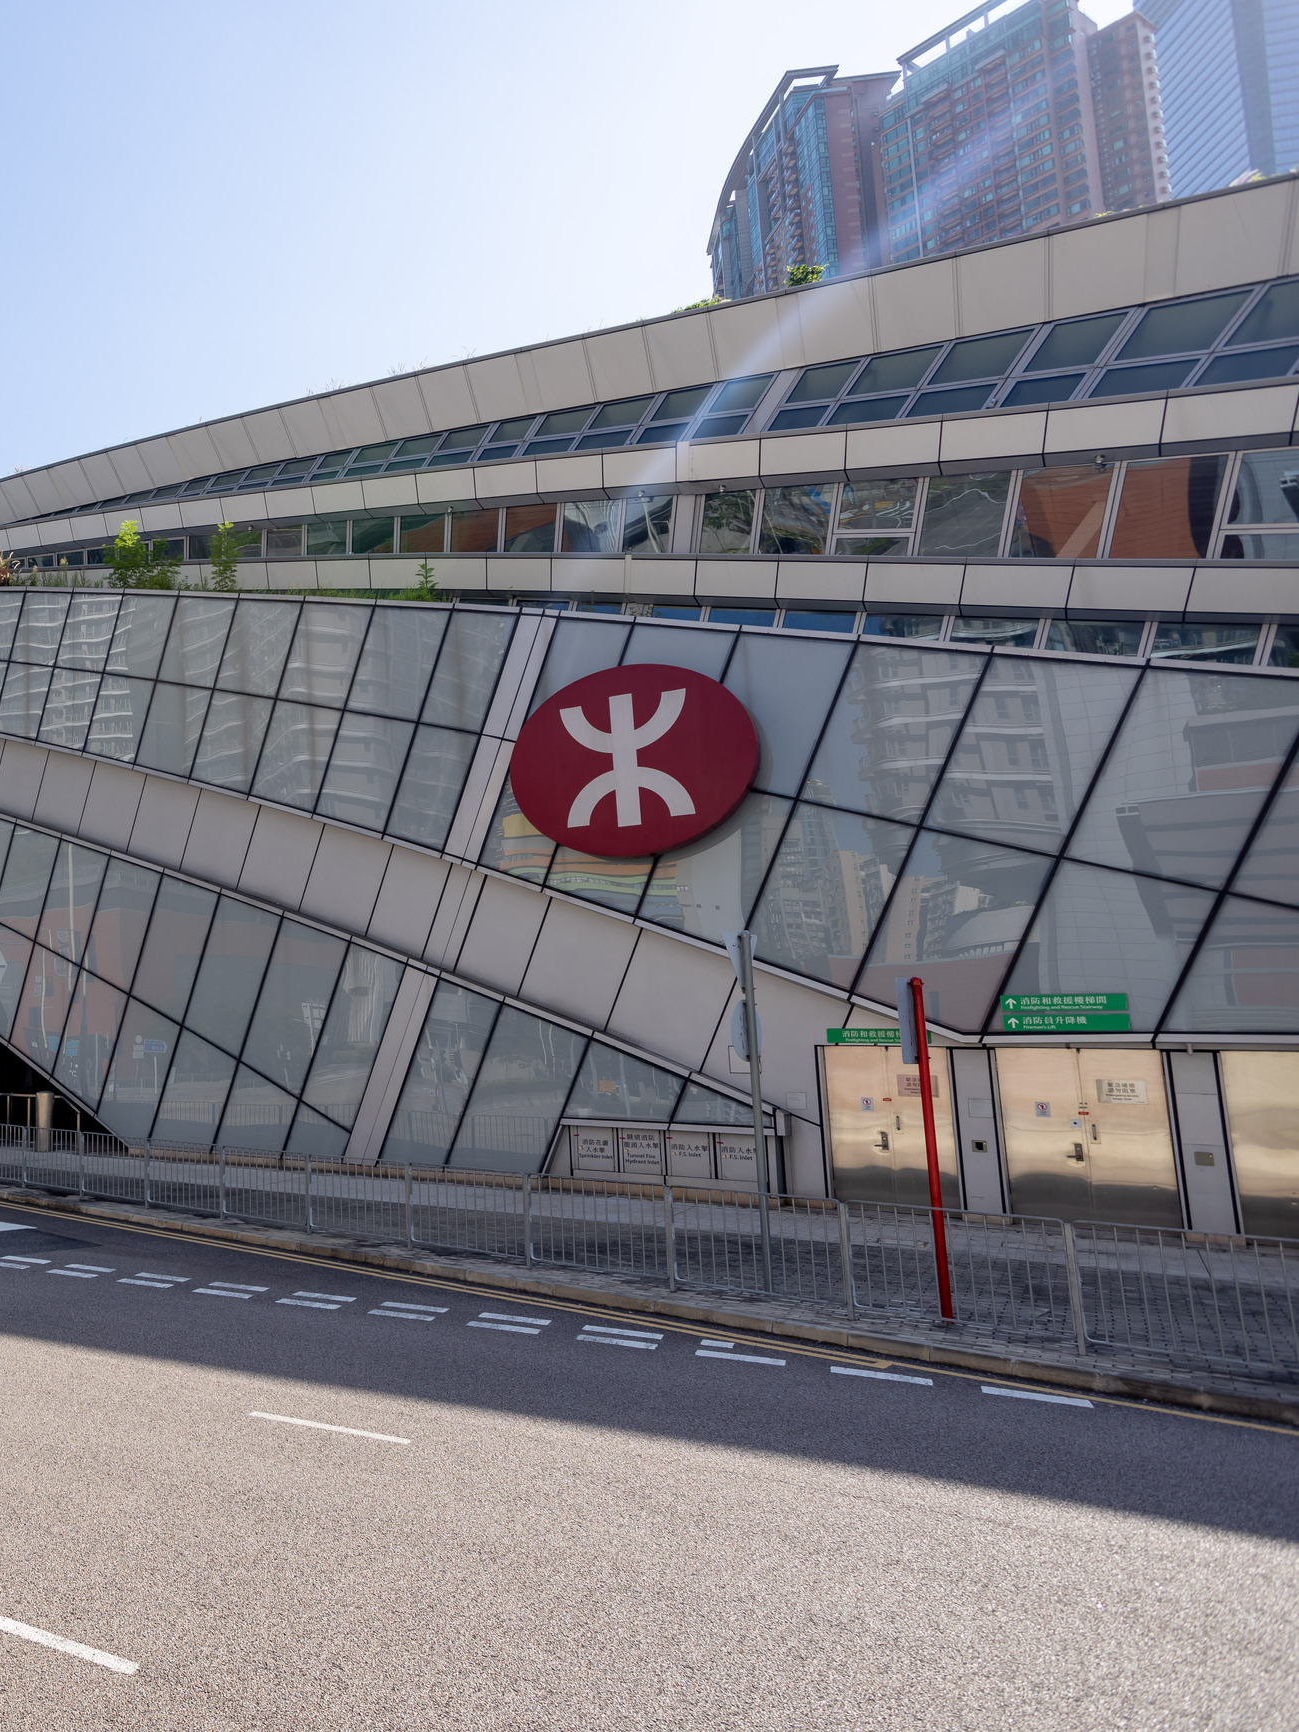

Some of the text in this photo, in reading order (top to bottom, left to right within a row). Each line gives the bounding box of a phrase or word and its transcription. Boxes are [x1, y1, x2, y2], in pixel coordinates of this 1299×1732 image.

[1020, 996, 1107, 1005] 消防和救援樓梯間
[1022, 1016, 1087, 1024] 消防員升降機
